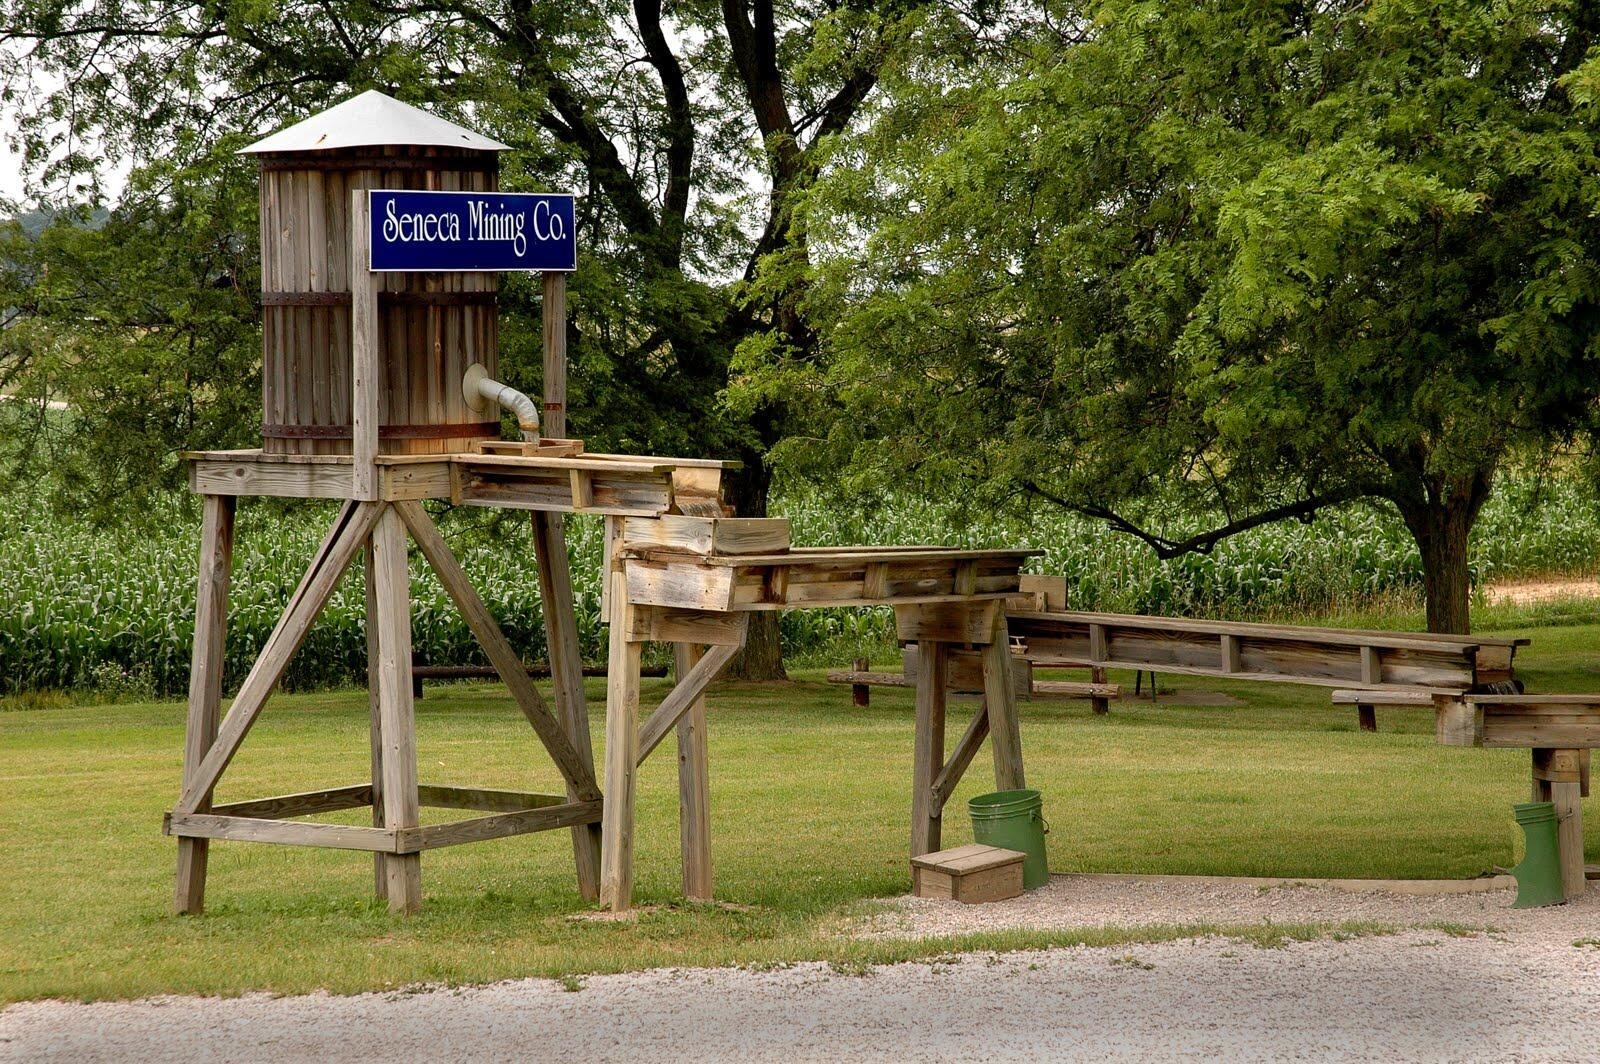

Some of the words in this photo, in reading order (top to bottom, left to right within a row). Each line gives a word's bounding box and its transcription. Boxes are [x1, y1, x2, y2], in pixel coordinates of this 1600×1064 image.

[383, 198, 460, 242] Seneca
[467, 201, 527, 257] Mining
[534, 199, 566, 241] Co.
